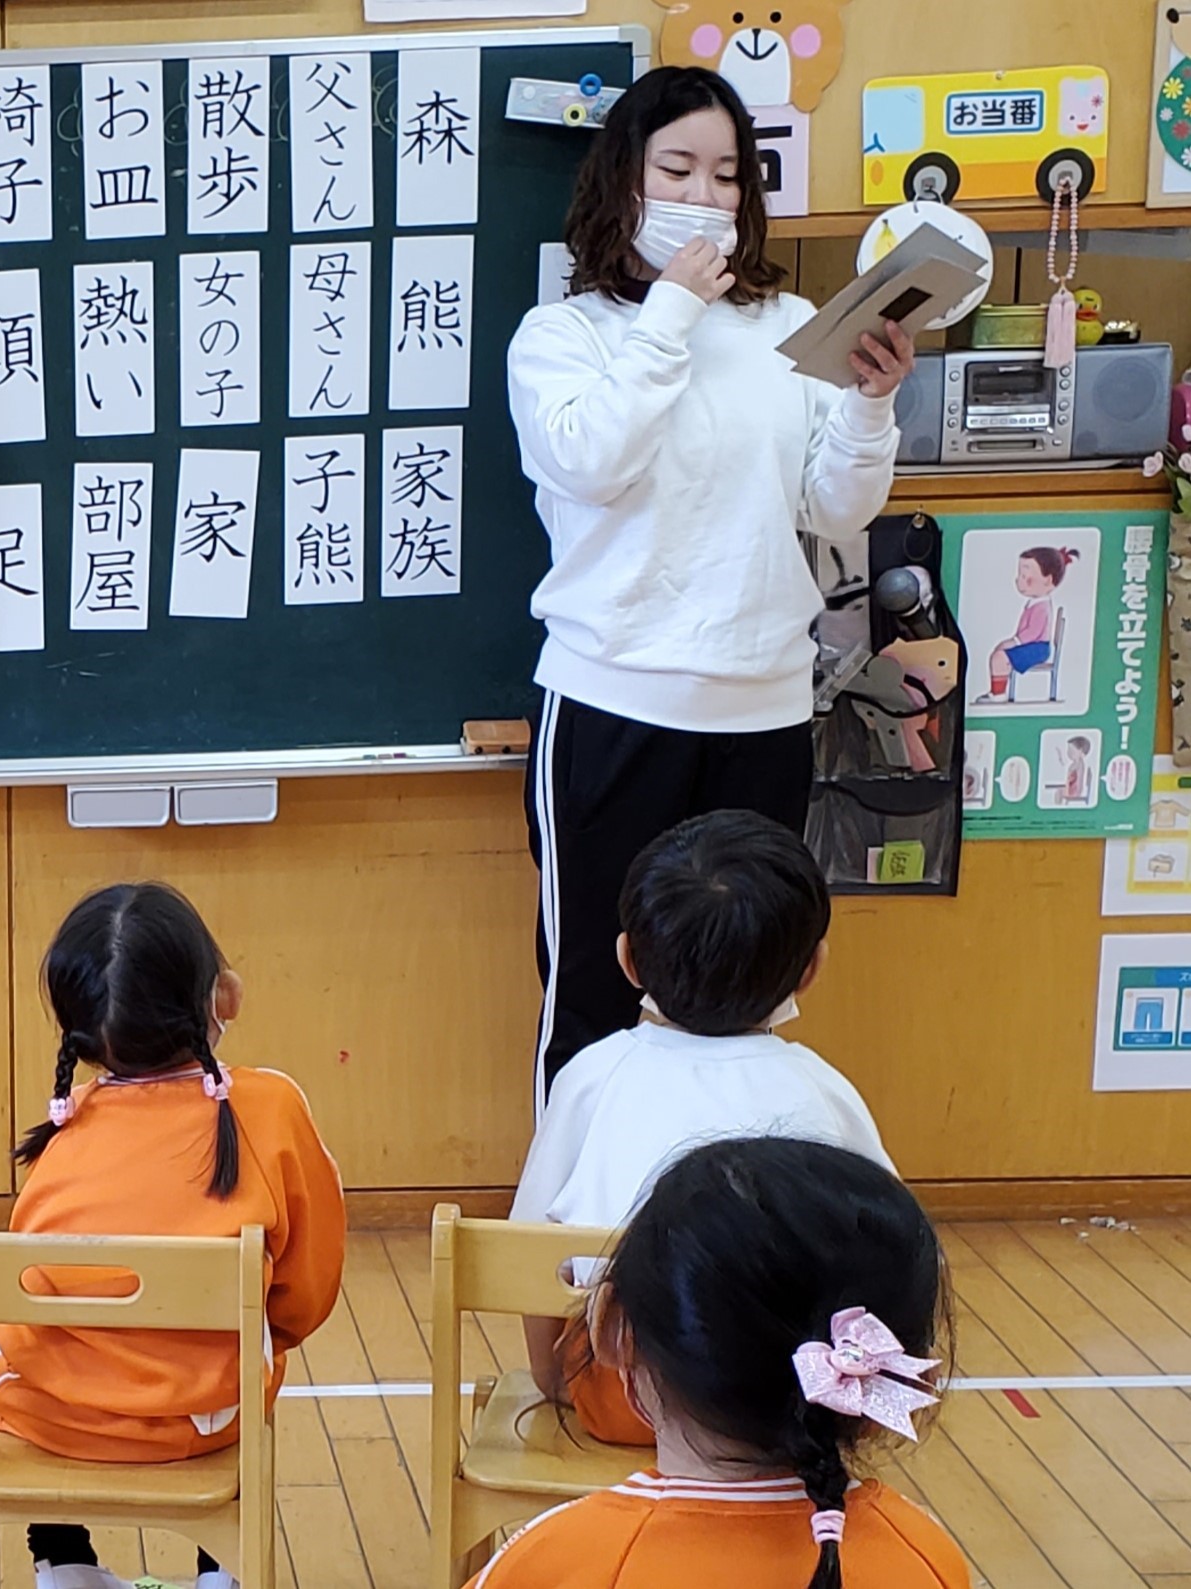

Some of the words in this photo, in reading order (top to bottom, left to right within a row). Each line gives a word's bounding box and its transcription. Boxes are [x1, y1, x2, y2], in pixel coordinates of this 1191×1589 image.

[90, 76, 158, 209] お皿
[194, 70, 265, 217] 散歩
[306, 62, 356, 223] 父さん
[402, 90, 474, 165] 森
[953, 97, 1037, 126] お当番
[79, 275, 148, 411] 熱い
[194, 257, 244, 418] 女の子
[303, 252, 357, 410] 母さん
[397, 280, 463, 353] 熊
[75, 475, 144, 612] 部屋
[181, 491, 246, 563] 家
[292, 450, 356, 589] 子熊
[386, 442, 456, 580] 家族
